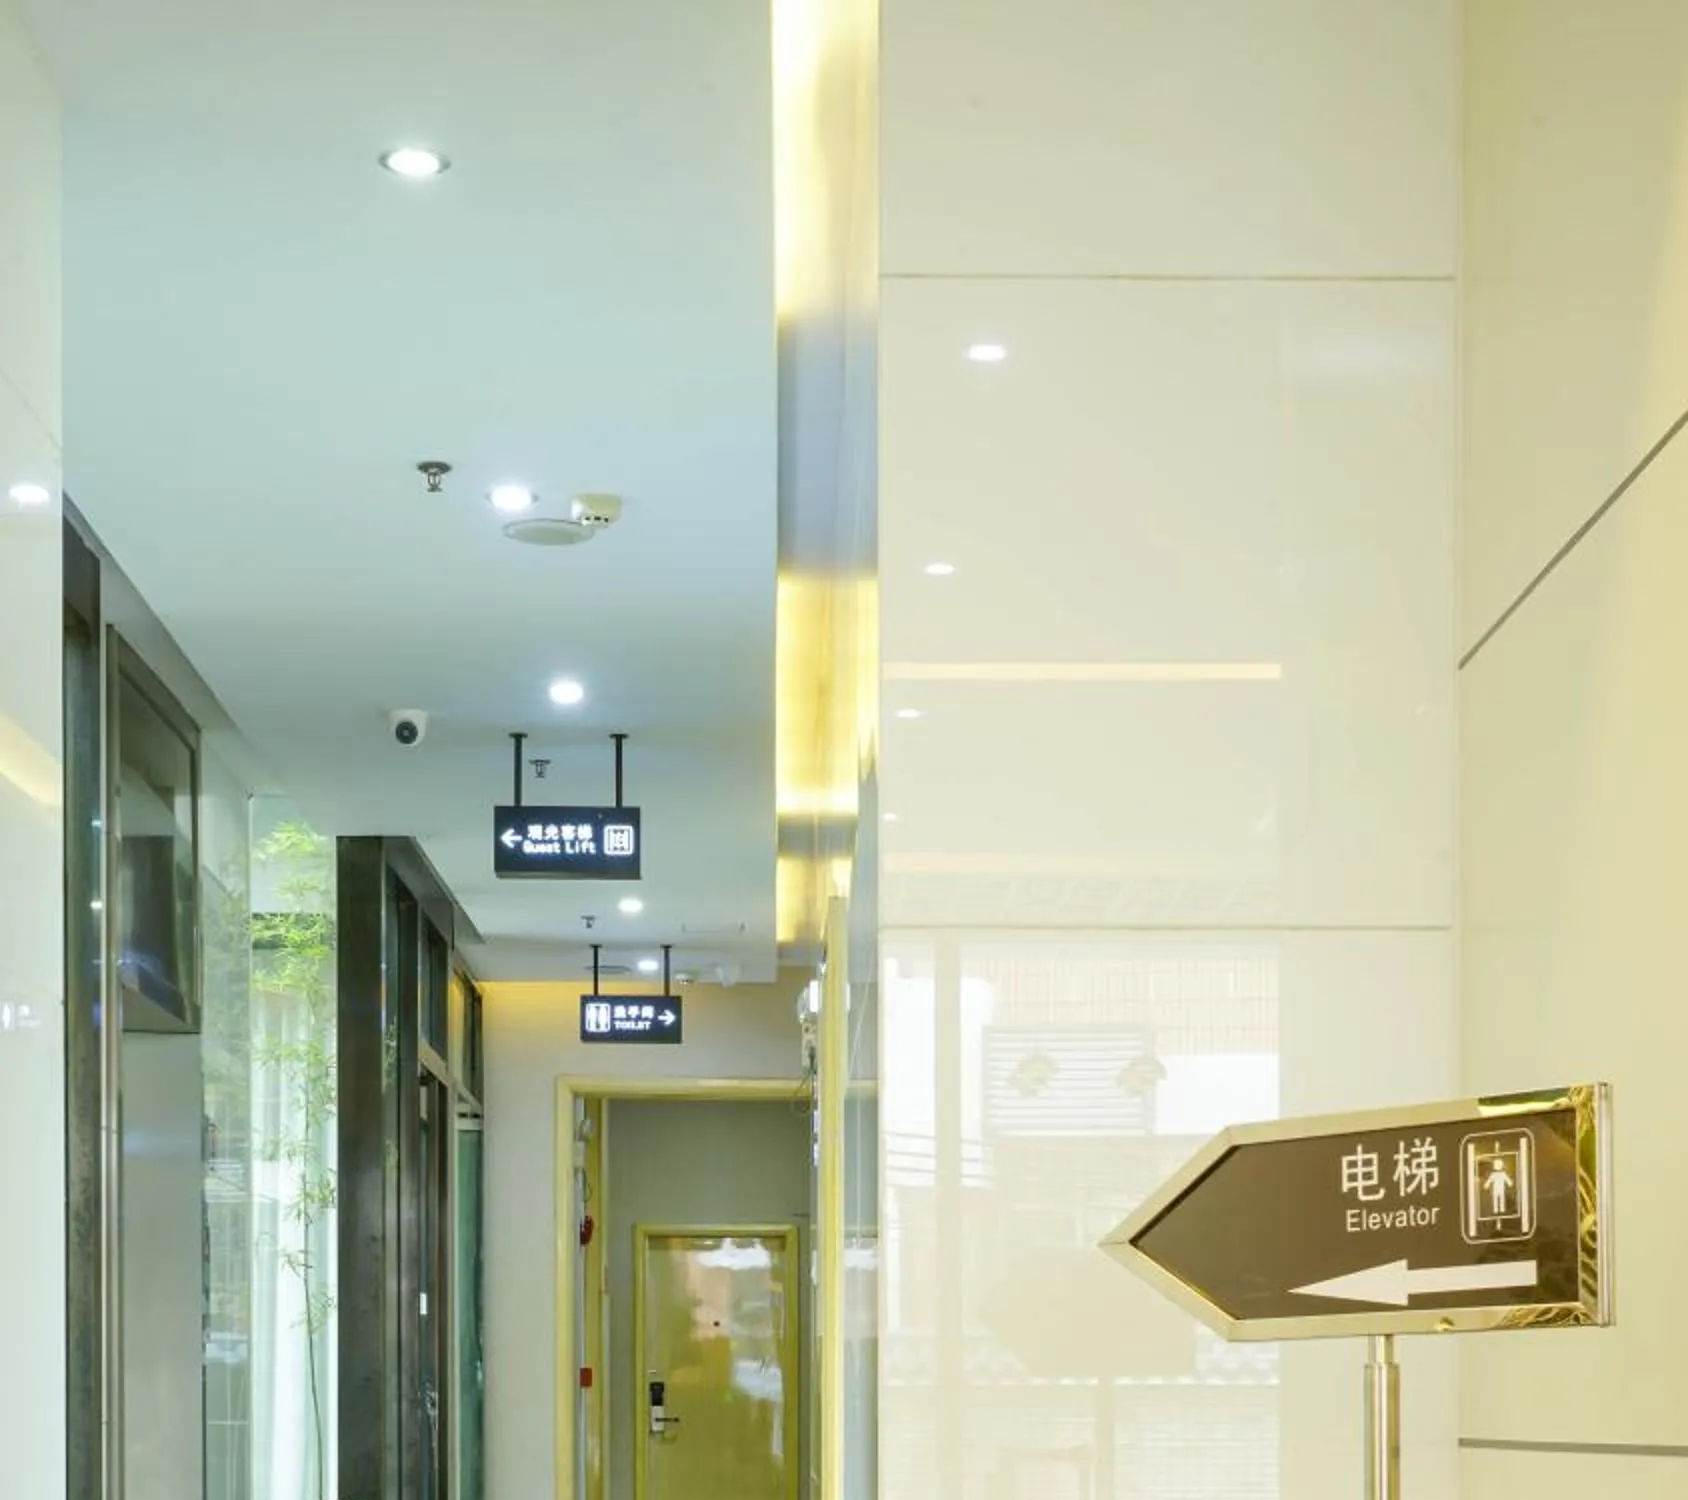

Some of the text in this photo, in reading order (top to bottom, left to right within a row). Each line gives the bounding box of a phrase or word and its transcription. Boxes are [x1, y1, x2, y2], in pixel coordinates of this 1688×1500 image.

[565, 840, 597, 854] Lift
[613, 1021, 652, 1031] TOILET
[1341, 1137, 1439, 1201] 电梯
[1345, 1204, 1441, 1233] Elevator
